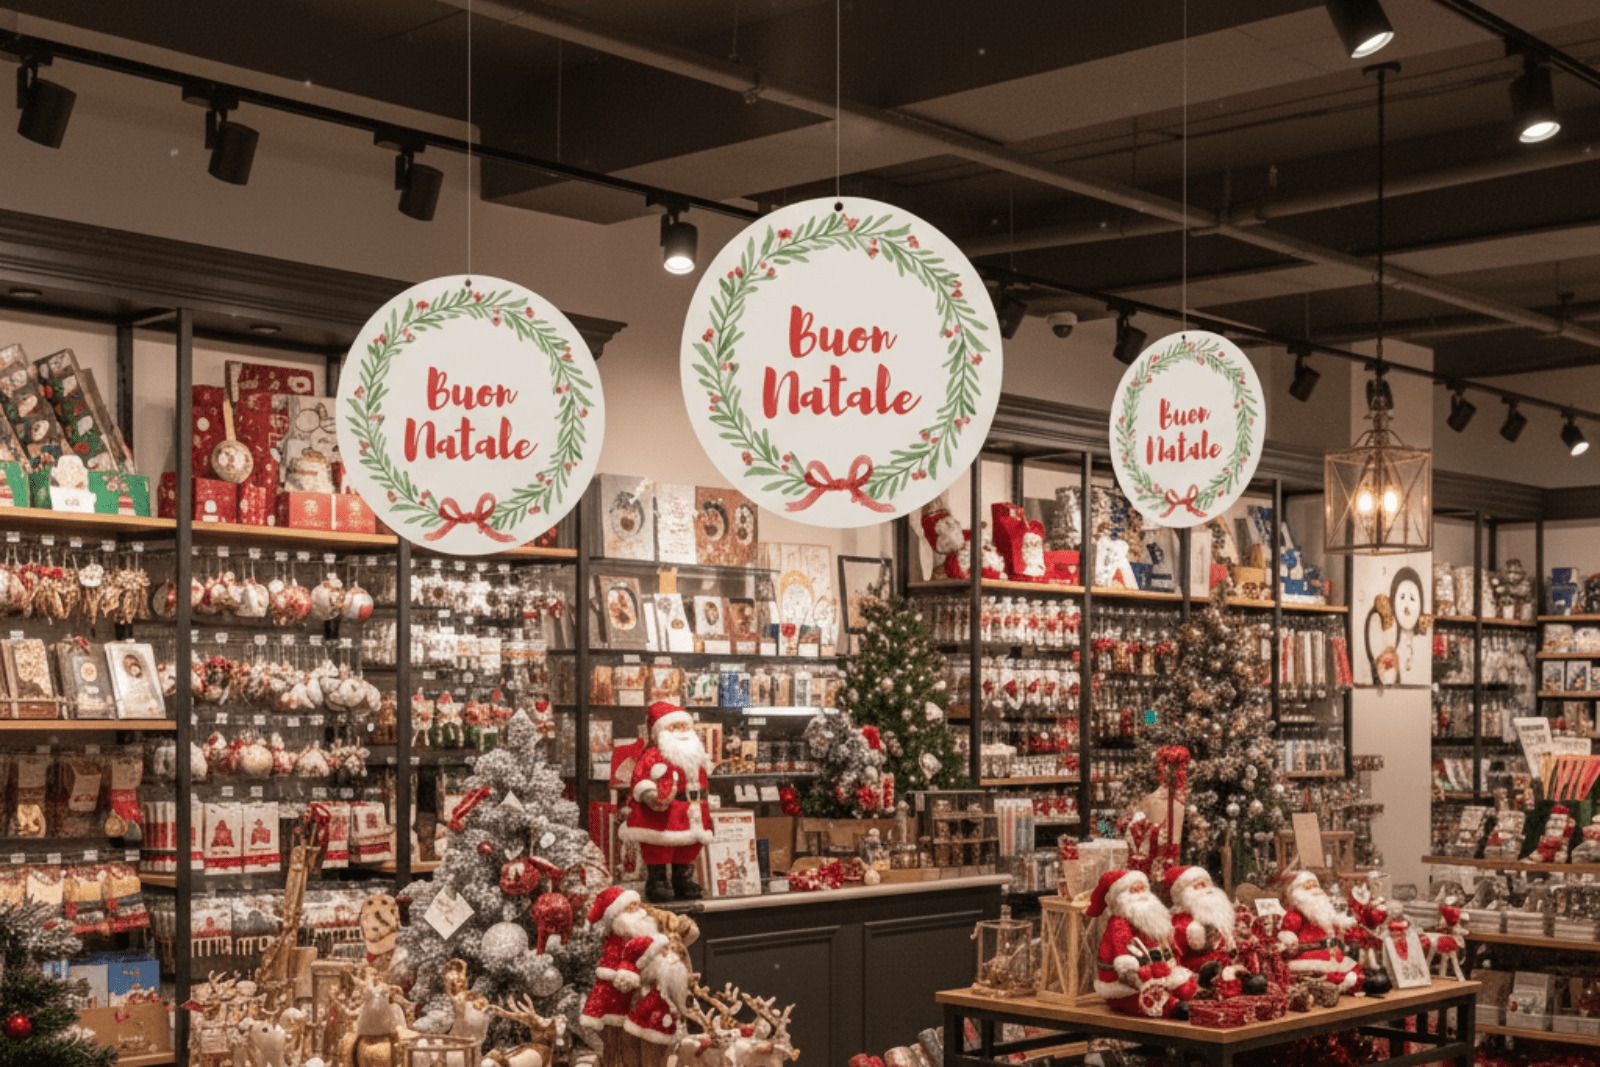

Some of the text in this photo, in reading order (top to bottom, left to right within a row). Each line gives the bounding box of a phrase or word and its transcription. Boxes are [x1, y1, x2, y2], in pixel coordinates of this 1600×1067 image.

[788, 305, 898, 358] Buon
[427, 366, 518, 411] Buon
[763, 363, 922, 419] Natale
[404, 416, 538, 463] Natale
[1146, 429, 1223, 466] Natale
